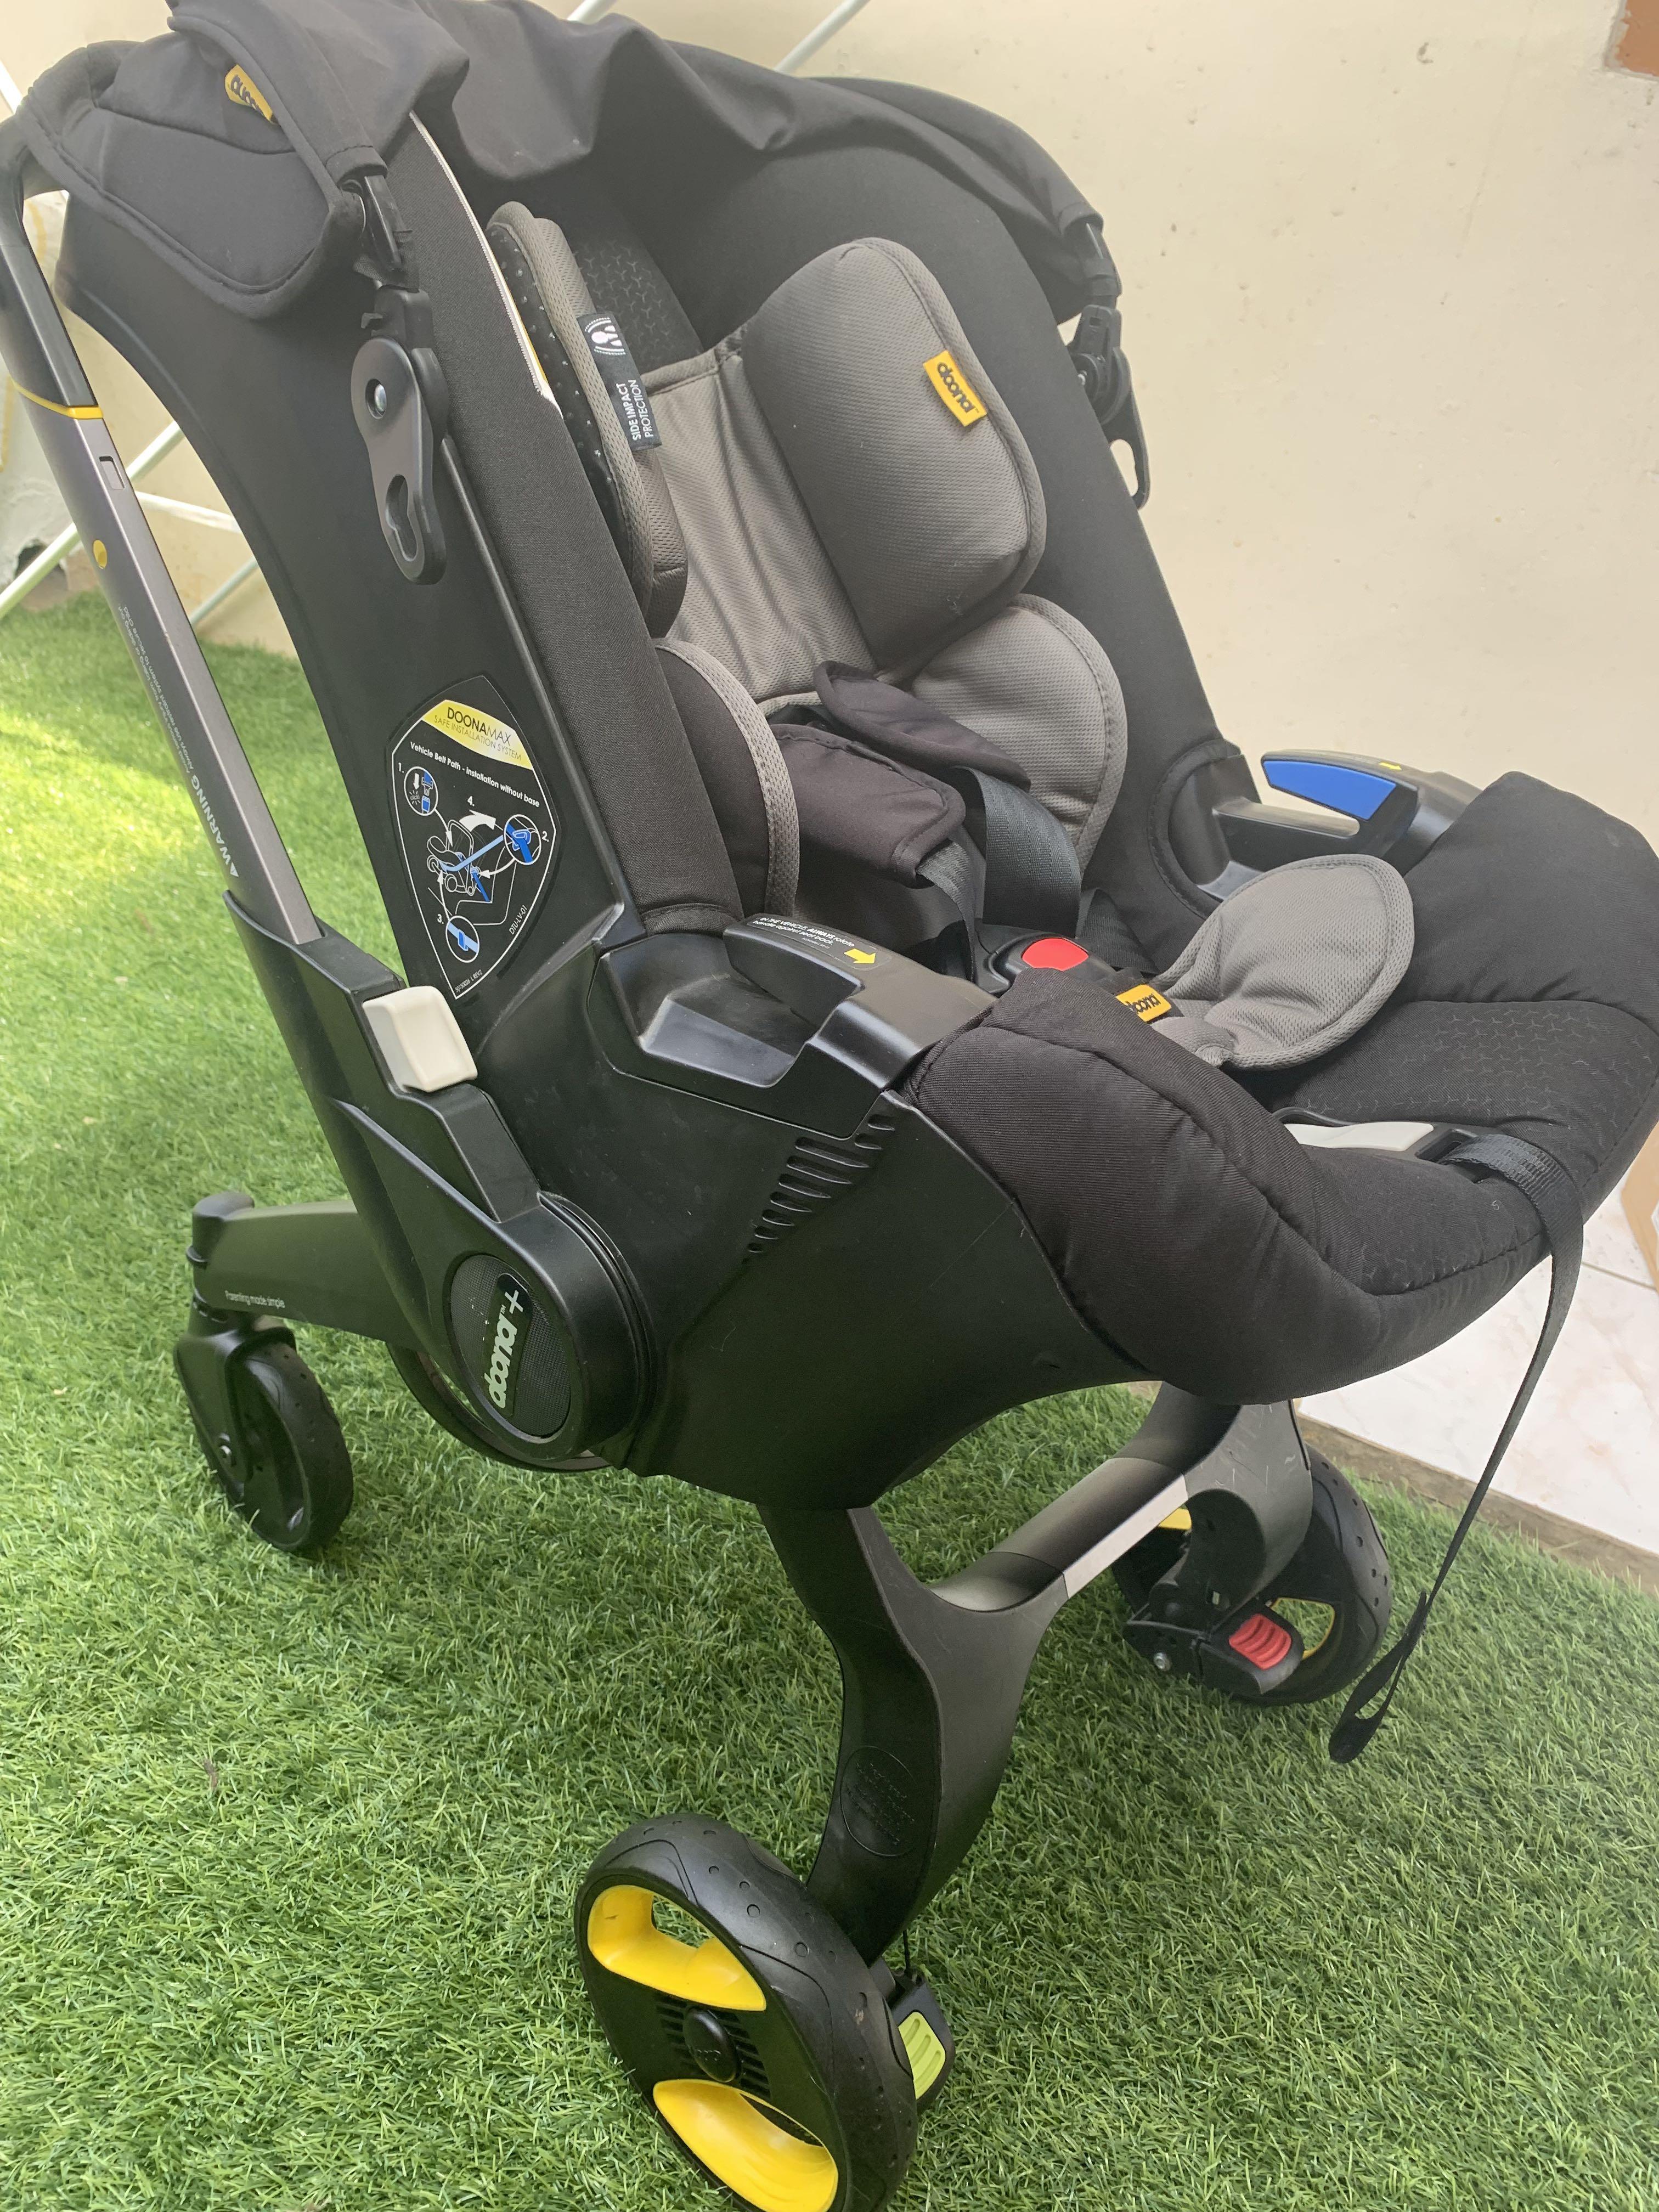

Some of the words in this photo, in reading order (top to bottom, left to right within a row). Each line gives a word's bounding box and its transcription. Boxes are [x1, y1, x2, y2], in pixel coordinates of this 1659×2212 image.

[230, 75, 266, 116] oona
[616, 383, 636, 419] IMPACT
[628, 380, 653, 438] PROTECTION
[629, 419, 642, 441] SIDE
[144, 656, 150, 666] to
[173, 727, 182, 741] use
[434, 715, 449, 729] SAFE
[451, 723, 496, 749] INSTALLATION
[498, 744, 522, 761] SYSTEM
[447, 707, 511, 746] DOONAMAX
[398, 763, 405, 774] 1.
[410, 741, 434, 758] Vehicle
[435, 752, 447, 763] Belt
[447, 758, 461, 771] Path
[466, 766, 499, 789] installation
[500, 783, 524, 800] without
[524, 792, 540, 808] base
[467, 795, 475, 807] 4.
[191, 775, 231, 865] WARNING
[541, 831, 549, 842] 2.
[437, 913, 444, 924] 3.
[776, 925, 802, 933] against
[780, 921, 808, 930] VEHICLE
[807, 928, 836, 939] ALWAYS
[833, 937, 855, 947] rotate
